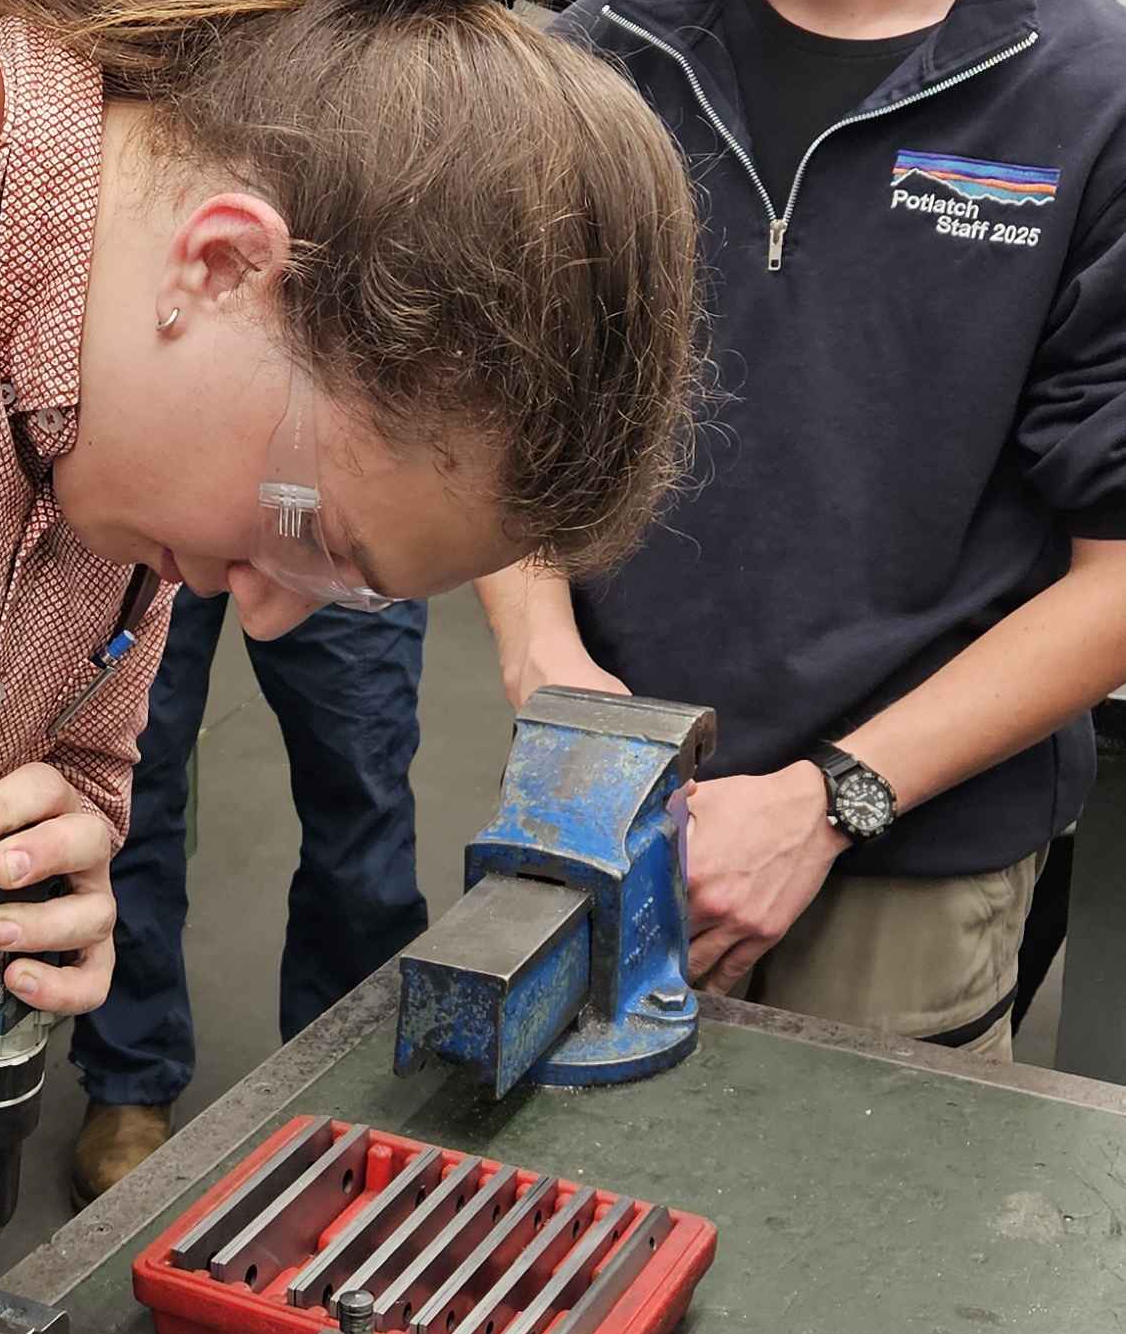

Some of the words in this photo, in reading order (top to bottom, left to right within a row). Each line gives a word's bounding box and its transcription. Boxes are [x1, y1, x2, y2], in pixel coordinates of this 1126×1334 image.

[890, 189, 980, 220] Potlatch
[936, 216, 990, 240] Staff
[989, 223, 1042, 247] 2025
